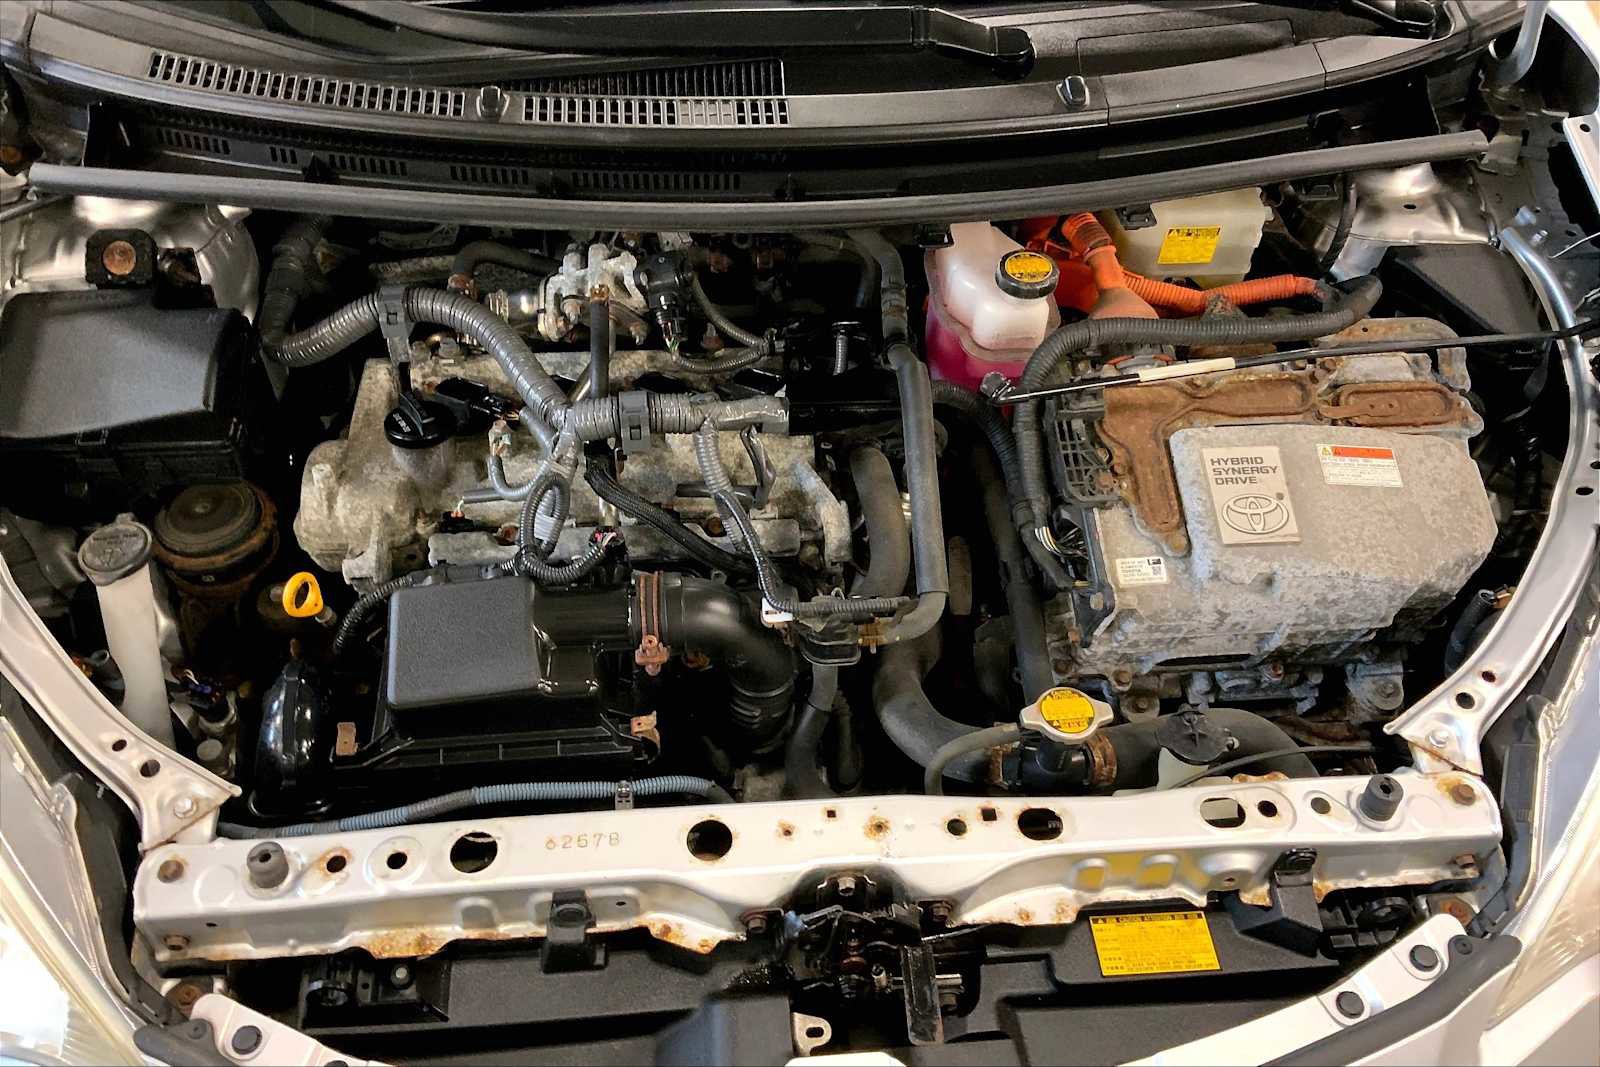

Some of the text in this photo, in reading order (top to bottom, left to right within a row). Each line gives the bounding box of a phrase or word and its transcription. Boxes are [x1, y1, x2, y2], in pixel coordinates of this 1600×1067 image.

[1210, 457, 1264, 466] HYBRID
[1212, 466, 1278, 476] SYNERGY
[1215, 476, 1258, 485] DRIVE
